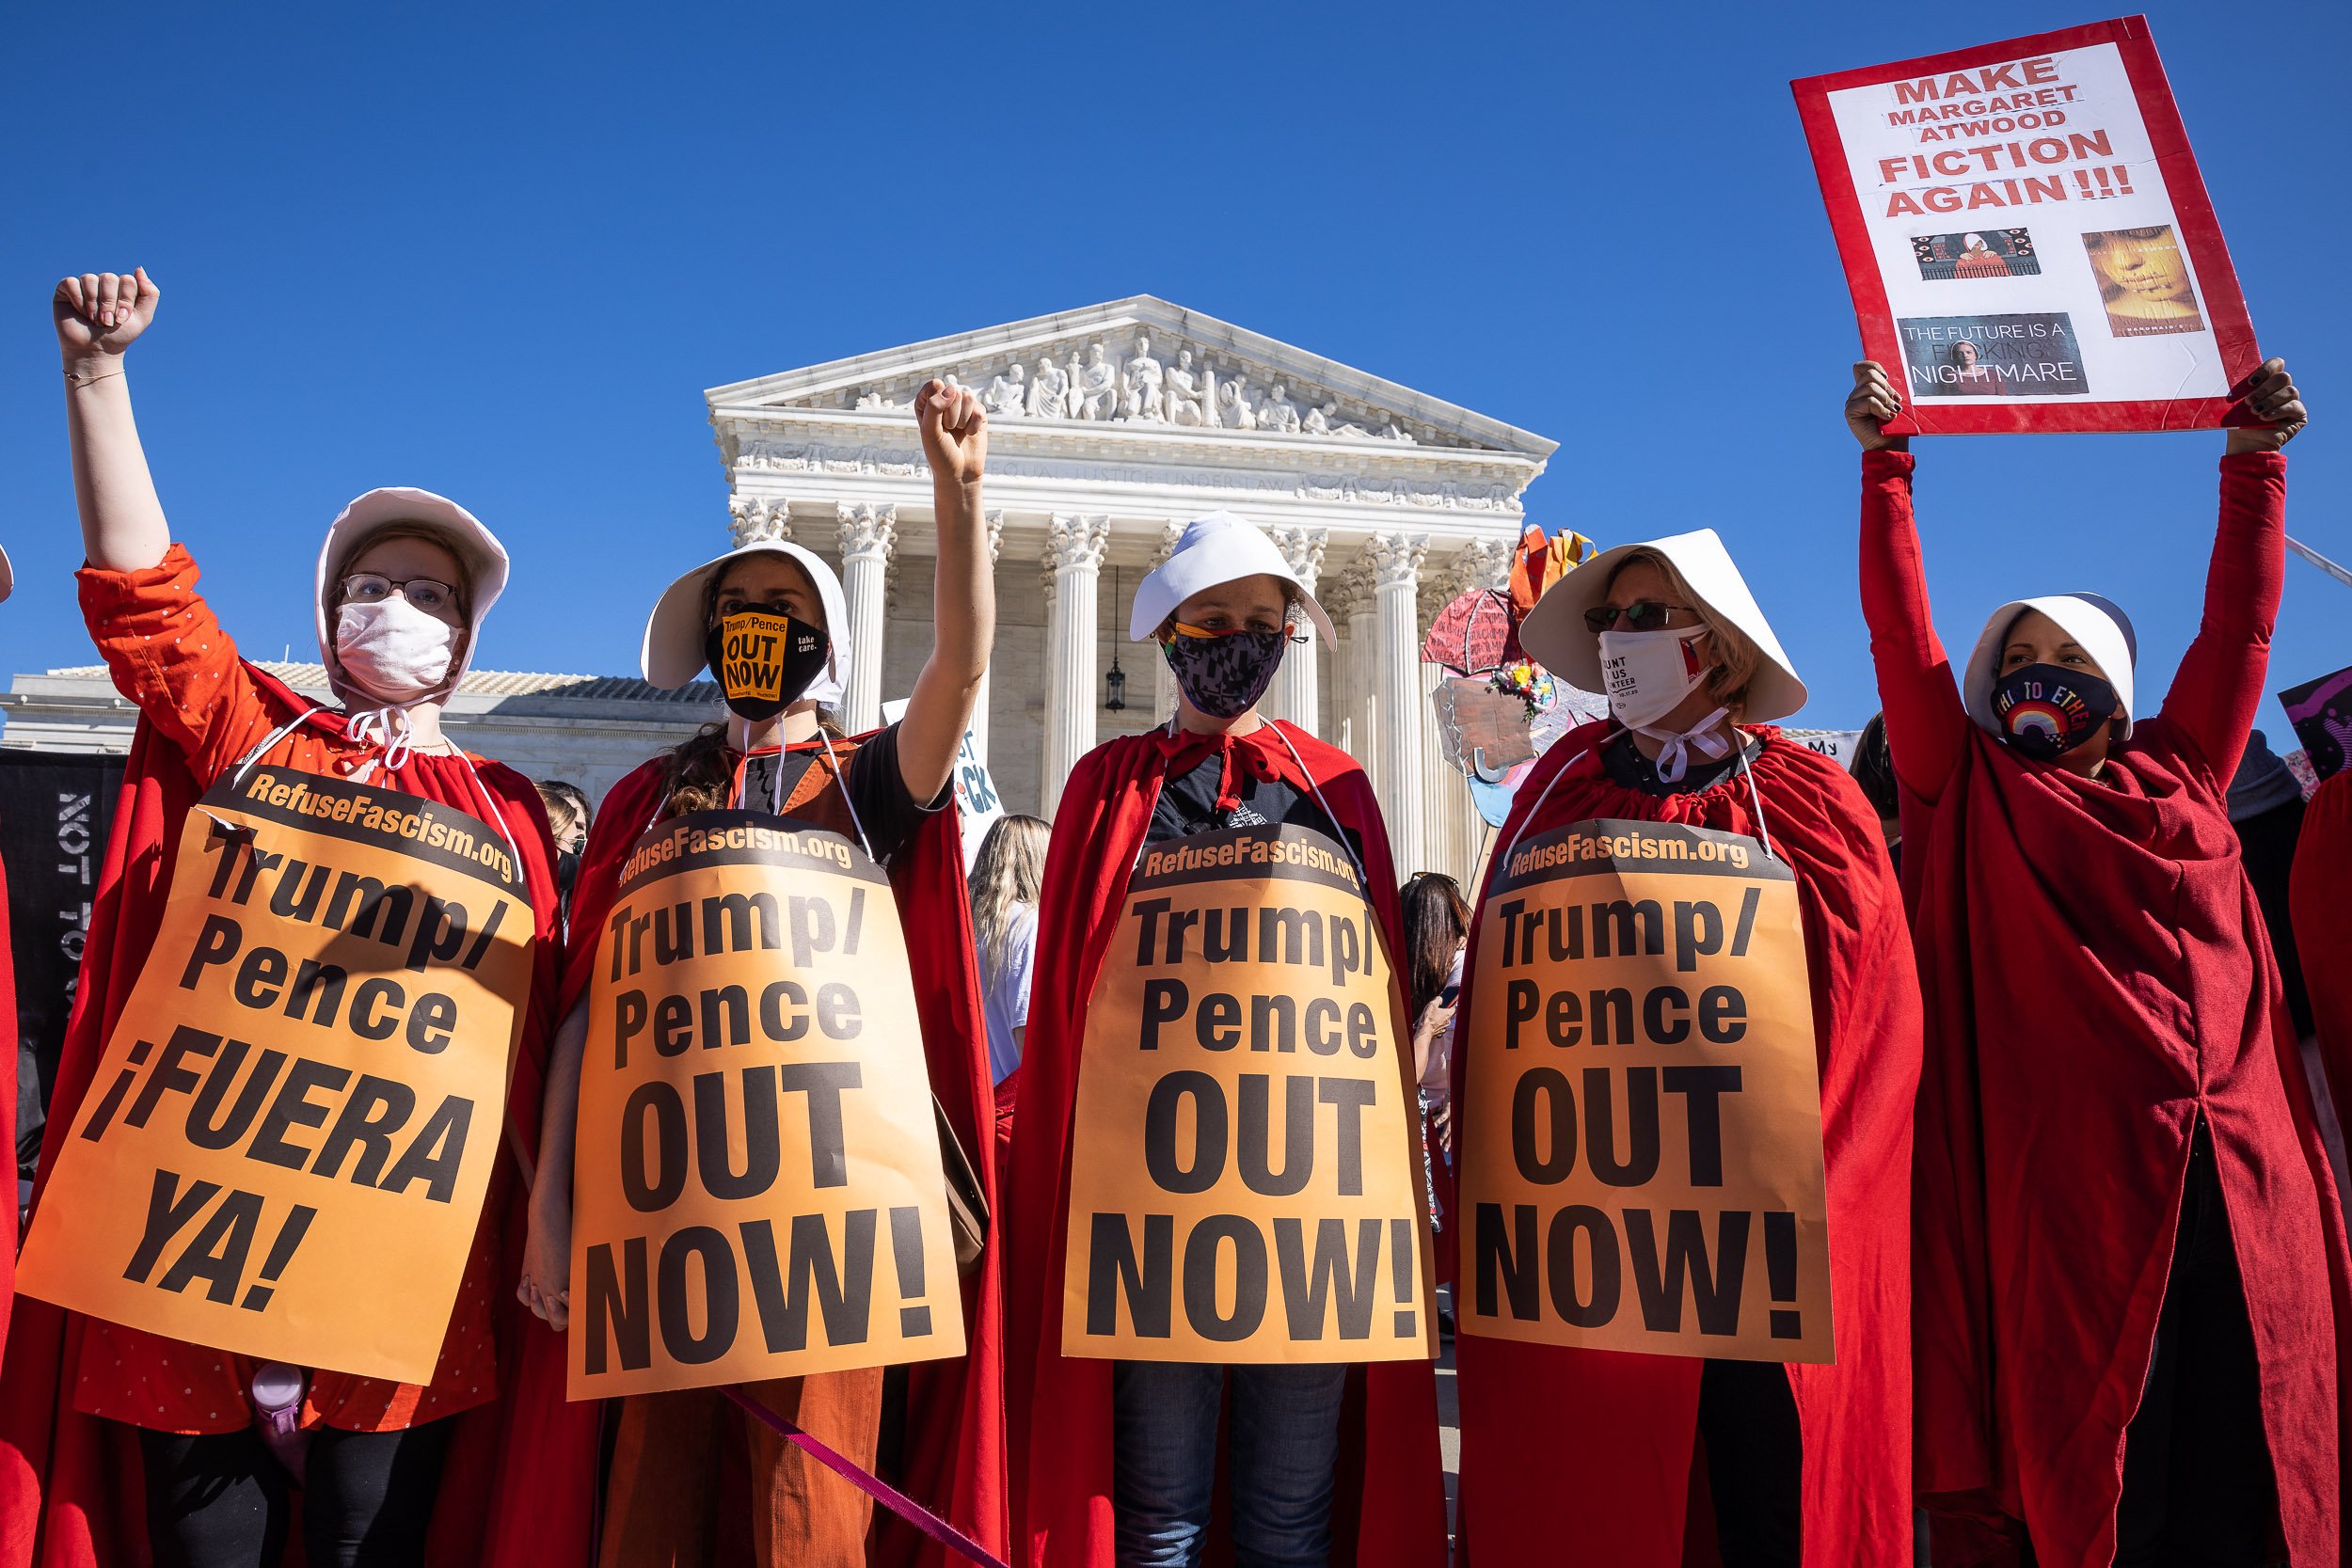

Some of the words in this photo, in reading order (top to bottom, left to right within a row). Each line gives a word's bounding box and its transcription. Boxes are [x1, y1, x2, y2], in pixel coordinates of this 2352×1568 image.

[1887, 84, 2078, 127] MARGARET
[1894, 56, 2059, 105] MAKE
[1920, 110, 2066, 143] ATWOOD
[1879, 129, 2114, 183] FICTION
[1904, 326, 1944, 341] THE
[1947, 325, 2026, 340] FUTURE
[2028, 324, 2046, 338] IS
[2052, 323, 2066, 337] A
[1931, 341, 2044, 361] FCKING
[1911, 361, 2077, 384] NIGHTMARE
[990, 461, 1060, 479] EQUAL
[1074, 465, 1154, 484] JUSTICE
[1165, 471, 1235, 489] UNDER
[1244, 476, 1286, 491] LAW
[724, 616, 786, 632] Trump/Pence
[727, 633, 777, 661] OUT
[798, 635, 815, 644] take
[798, 644, 818, 653] care.
[725, 660, 780, 689] NOW
[1610, 677, 1636, 689] NTEER
[1612, 669, 1627, 679] US
[2024, 681, 2090, 731] TOETHER
[57, 794, 91, 885] NOT
[246, 773, 513, 884] RefuseFascism.org
[1510, 832, 1750, 879] RefuseFascism.org
[1145, 835, 1360, 891] RefuseFascism.org
[207, 815, 509, 974] Trump/
[611, 887, 866, 984] Trump/
[1500, 887, 1761, 973] Trump/
[178, 913, 457, 1055] Pence
[614, 981, 863, 1070] Pence
[1139, 978, 1377, 1060] Pence
[1505, 978, 1748, 1050] Pence
[80, 1024, 475, 1204] ¡FUERA
[620, 1062, 863, 1213] OUT
[1144, 1069, 1376, 1196] OUT
[1511, 1066, 1743, 1188] OUT
[122, 1168, 318, 1313] YA!
[584, 1206, 934, 1376] NOW!
[1086, 1212, 1417, 1342] NOW!
[1475, 1202, 1803, 1340] NOW!
